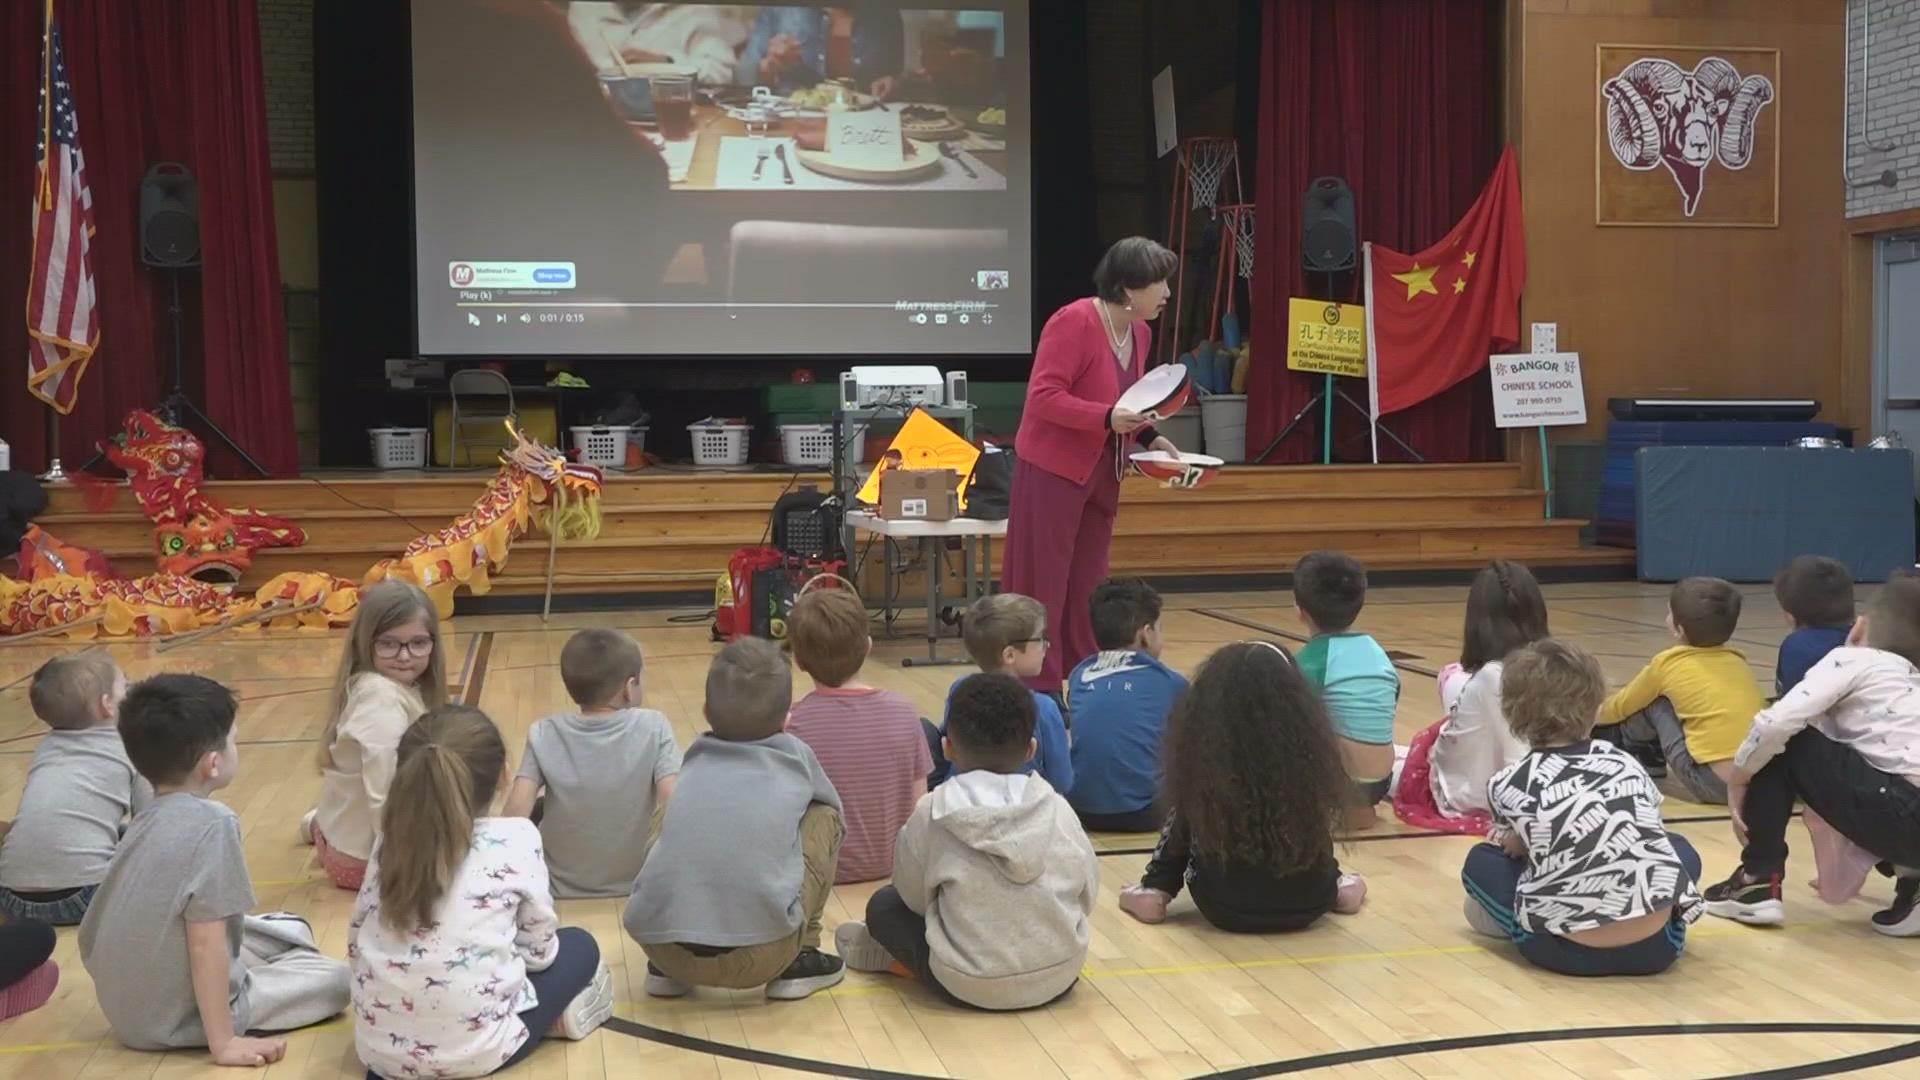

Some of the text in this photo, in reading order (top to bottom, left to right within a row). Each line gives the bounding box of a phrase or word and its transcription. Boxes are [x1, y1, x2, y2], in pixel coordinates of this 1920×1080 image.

[460, 290, 492, 301] Play (k)
[540, 313, 557, 322] 0:01
[566, 313, 584, 322] 0:15
[1300, 324, 1360, 344] 孔子学院
[1310, 351, 1330, 360] Chinese
[1318, 362, 1336, 371] Center
[1510, 360, 1559, 373] BANGOR
[1501, 380, 1574, 391] CHINESE SCHOOL
[1540, 774, 1585, 808] NIKE
[1569, 802, 1610, 844] NIKE
[1602, 822, 1642, 863] NIKE
[1650, 866, 1679, 899] NIKE
